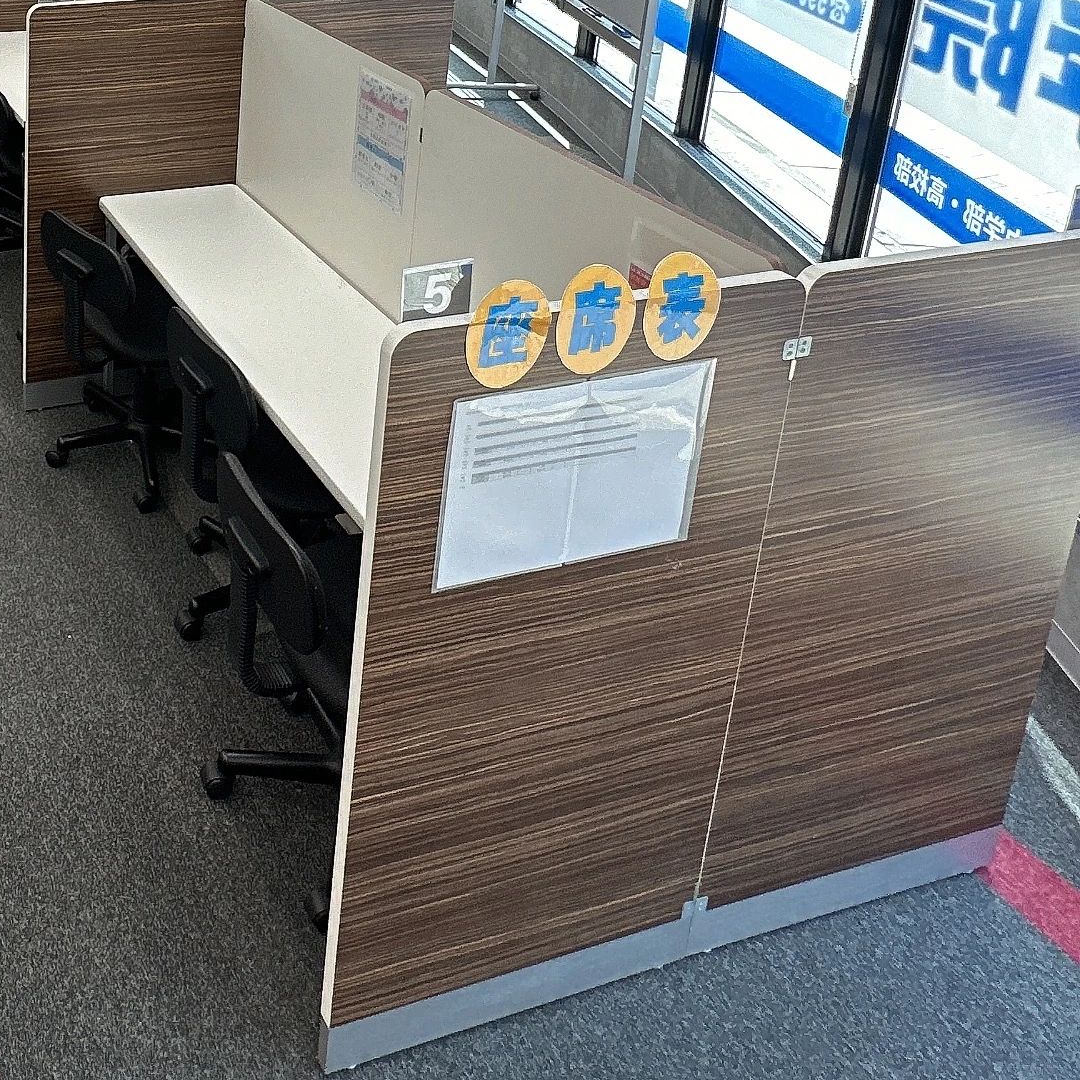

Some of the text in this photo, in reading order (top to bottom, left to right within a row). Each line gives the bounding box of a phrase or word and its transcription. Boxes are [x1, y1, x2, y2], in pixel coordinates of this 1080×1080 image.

[422, 271, 453, 315] 5
[478, 271, 705, 370] 座席表
